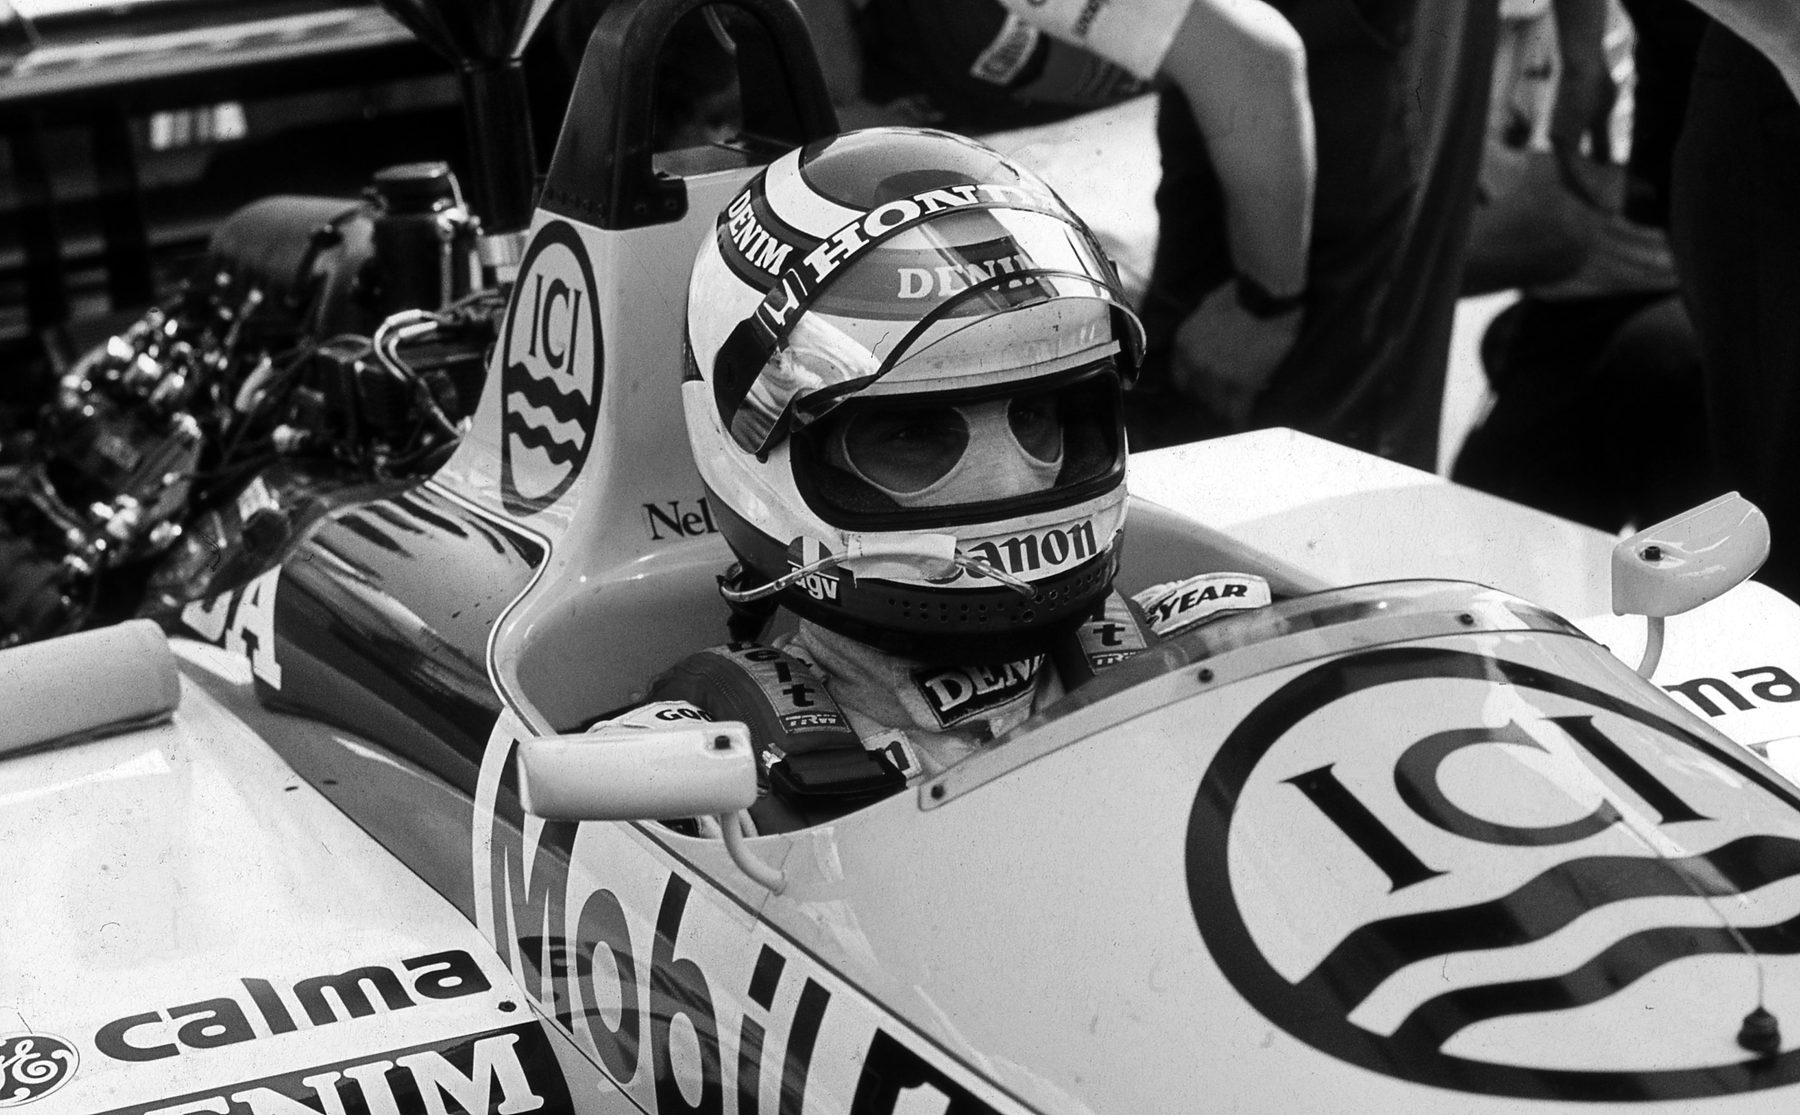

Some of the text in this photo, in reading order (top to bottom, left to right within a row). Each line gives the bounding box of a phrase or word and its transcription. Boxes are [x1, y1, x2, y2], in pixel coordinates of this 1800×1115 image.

[728, 189, 794, 276] DENIM
[528, 273, 583, 376] ICI
[642, 496, 719, 541] Nel
[925, 519, 1097, 585] anon
[1146, 584, 1249, 624] YEAR
[1276, 714, 1720, 896] ICI
[94, 949, 493, 1063] calma
